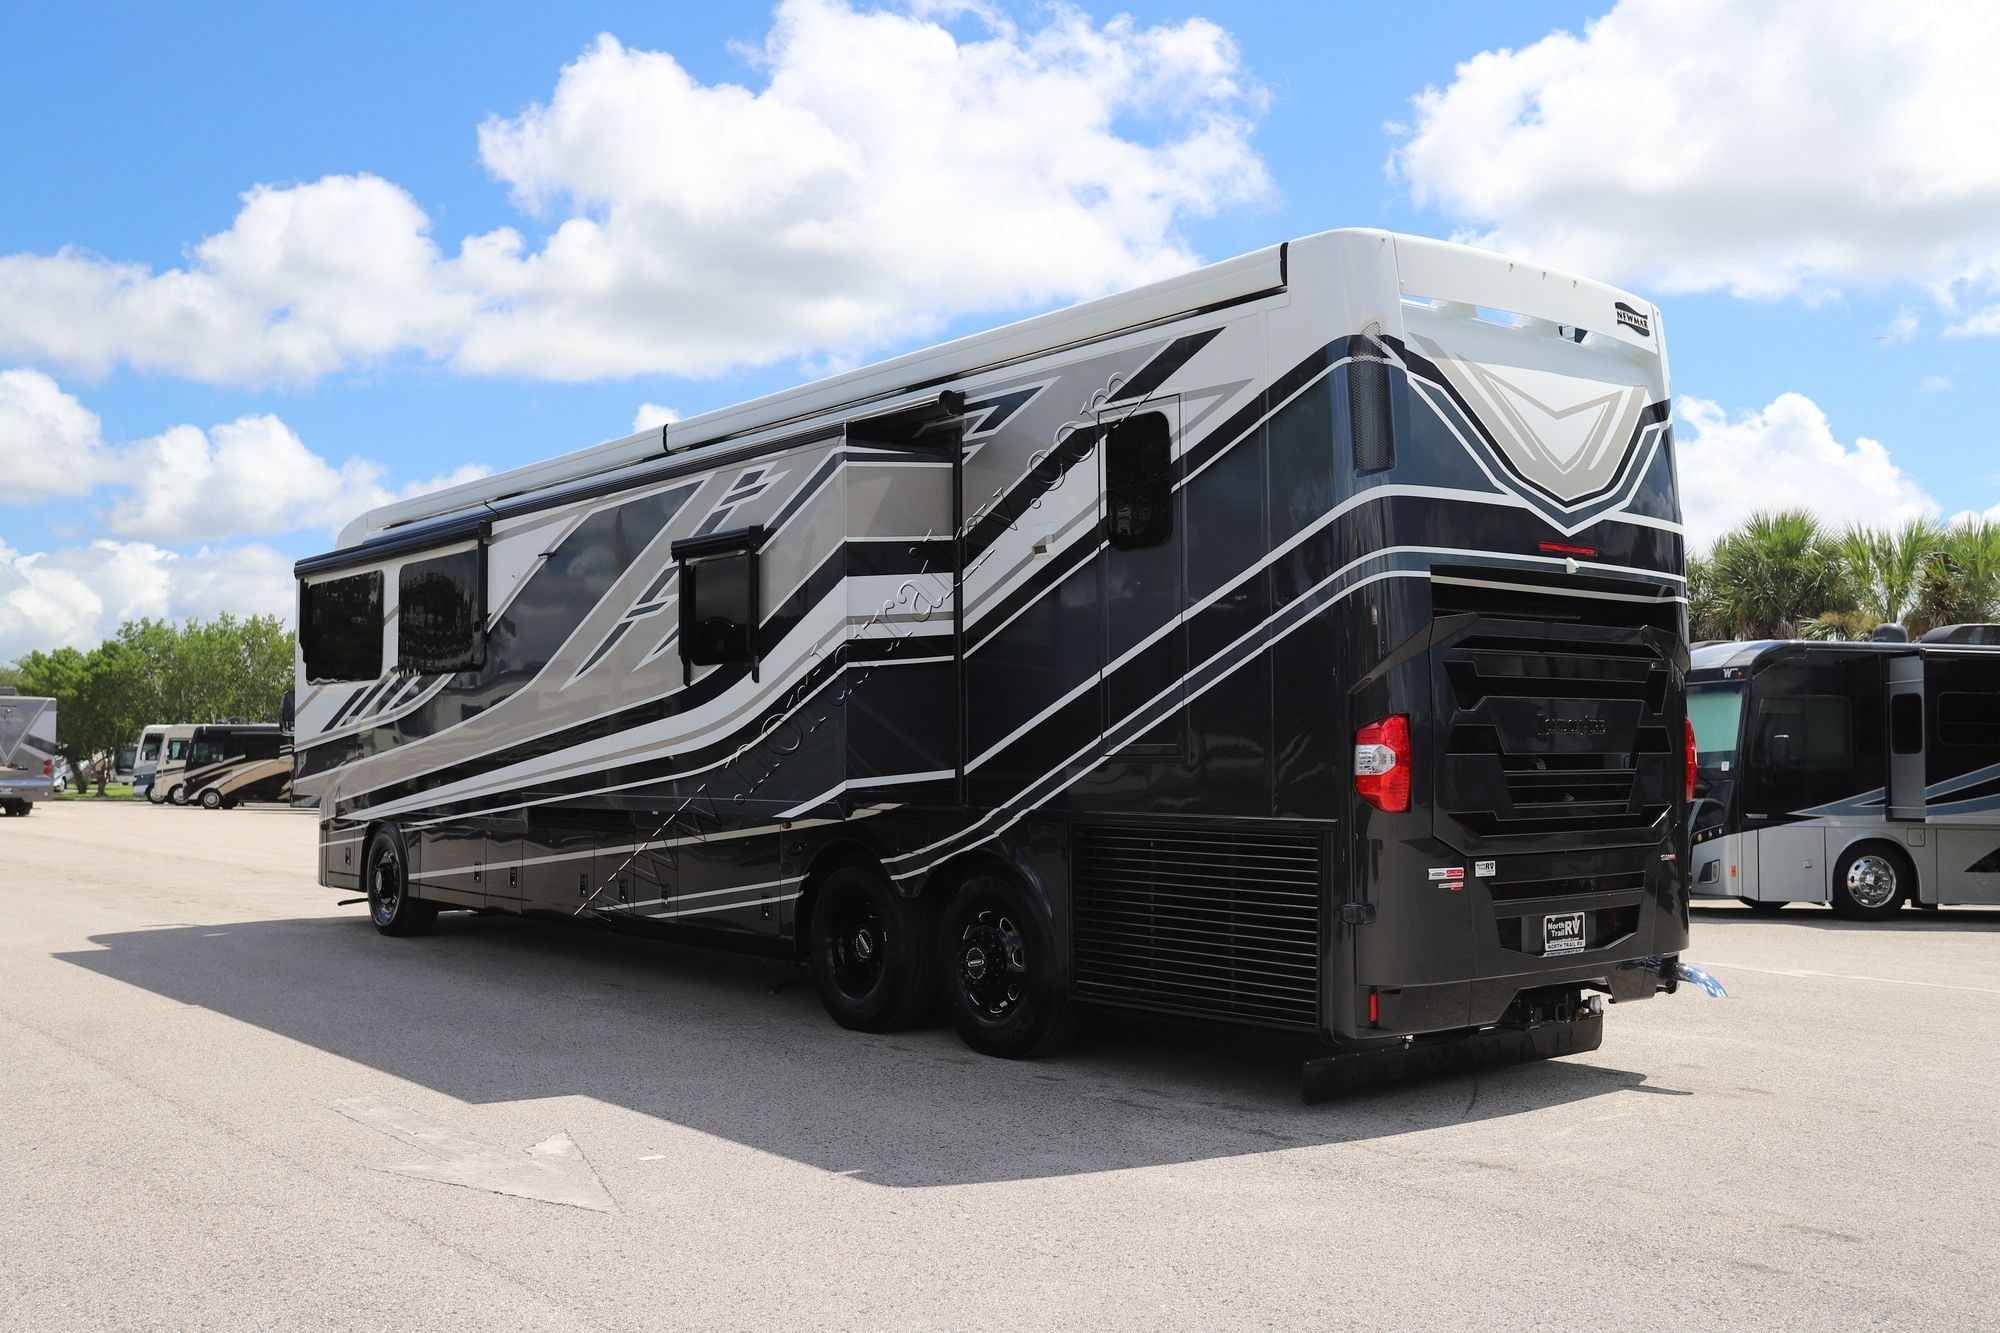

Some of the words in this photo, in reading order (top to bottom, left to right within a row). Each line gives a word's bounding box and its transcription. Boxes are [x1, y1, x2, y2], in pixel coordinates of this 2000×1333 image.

[1617, 310, 1648, 328] NEWMAR
[1548, 922, 1564, 930] North
[1565, 919, 1580, 935] RV
[1551, 929, 1564, 937] Trail
